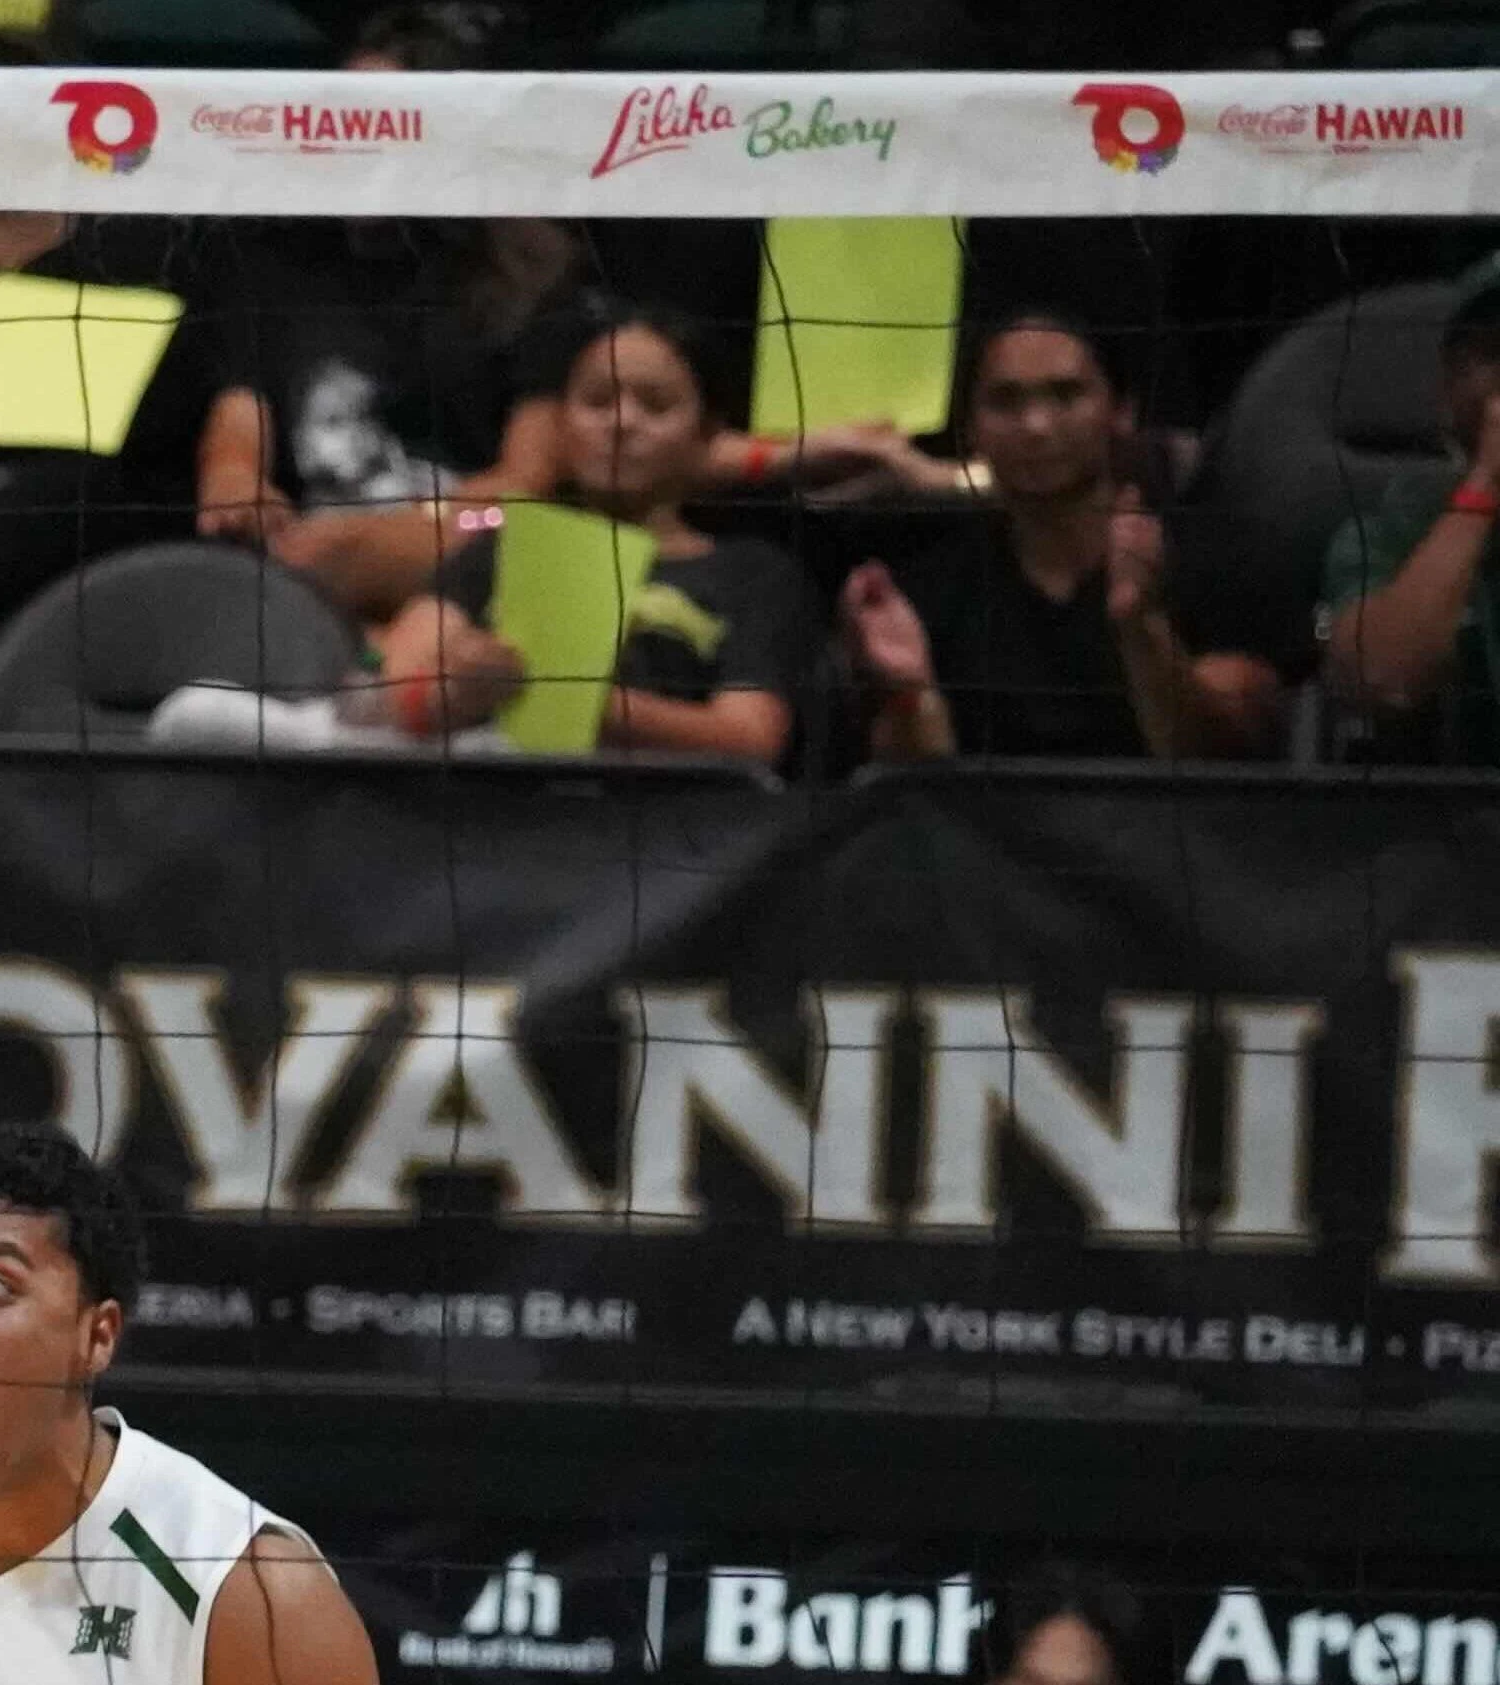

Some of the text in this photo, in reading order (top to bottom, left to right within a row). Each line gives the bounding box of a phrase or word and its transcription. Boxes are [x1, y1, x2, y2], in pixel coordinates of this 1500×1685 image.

[283, 105, 422, 141] HAWAII
[745, 96, 897, 161] Bakery
[1316, 104, 1463, 141] HAWAII
[703, 1565, 995, 1676] Bank
